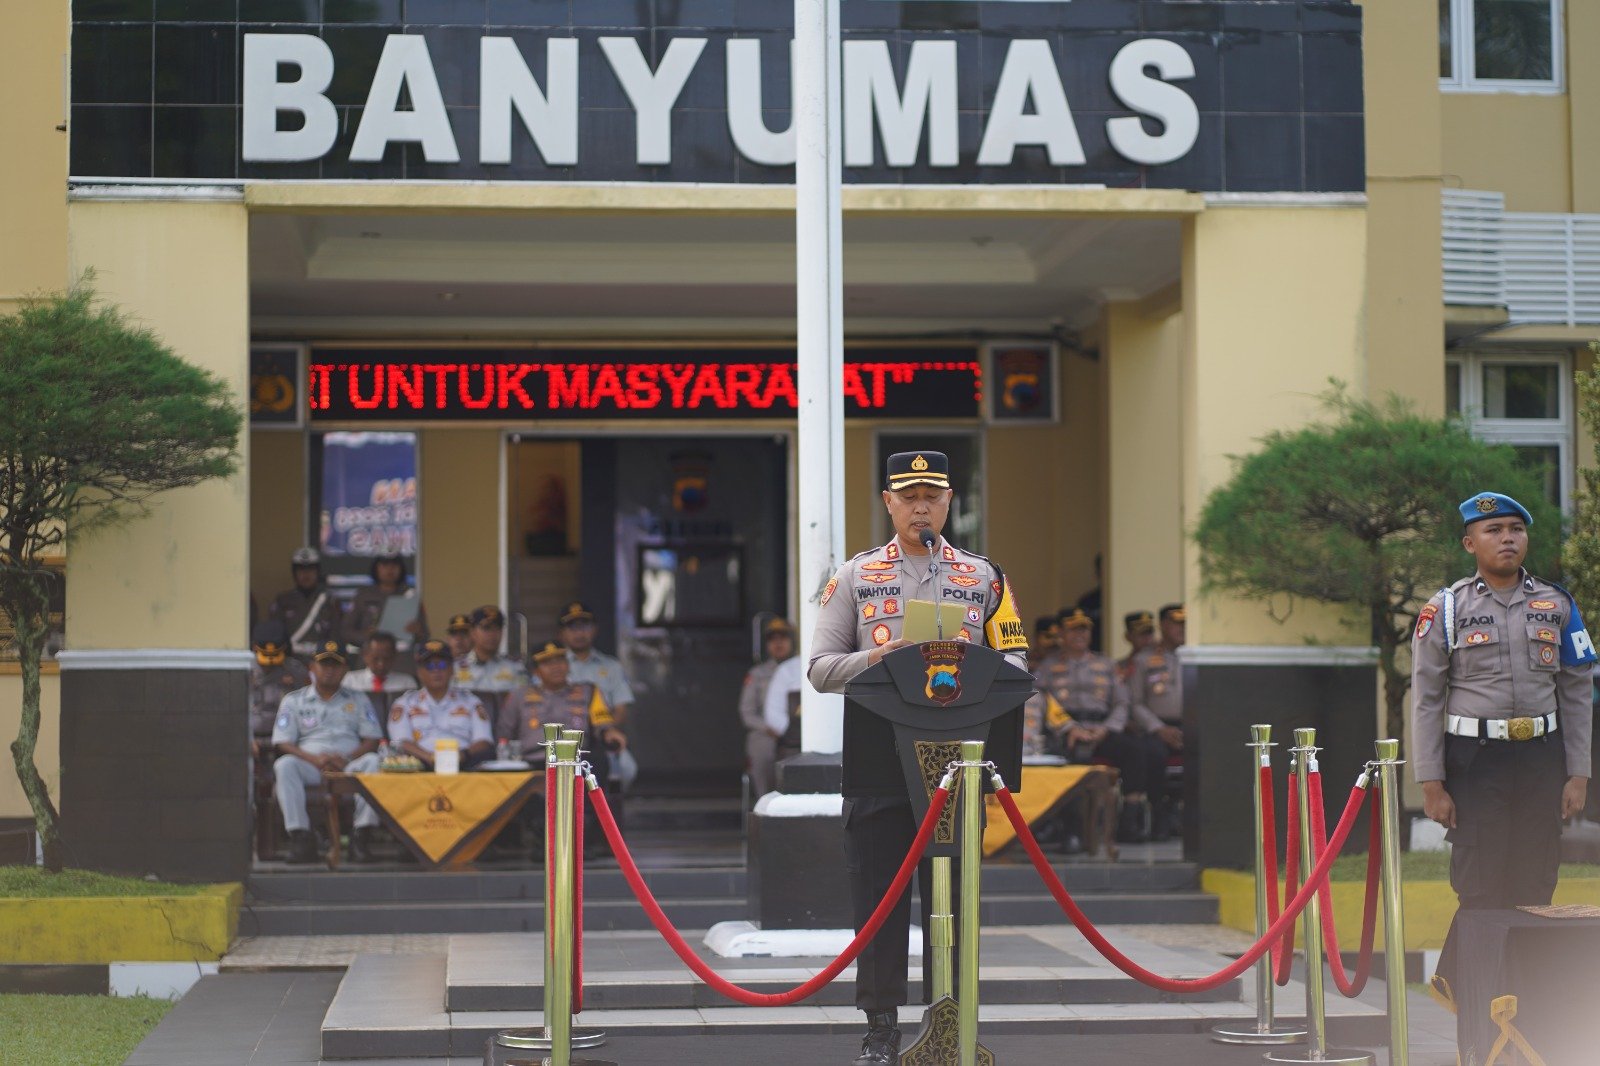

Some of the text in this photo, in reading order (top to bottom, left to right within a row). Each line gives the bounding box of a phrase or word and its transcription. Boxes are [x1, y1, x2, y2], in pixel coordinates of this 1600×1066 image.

[242, 33, 1200, 167] BANYUMAS
[348, 365, 535, 409] UNTUK
[547, 365, 914, 409] MASYARAAT"
[858, 586, 900, 600] WAHYUDI
[942, 588, 984, 604] POLRI
[1459, 615, 1495, 629] ZAQI
[1526, 612, 1561, 626] POLRI
